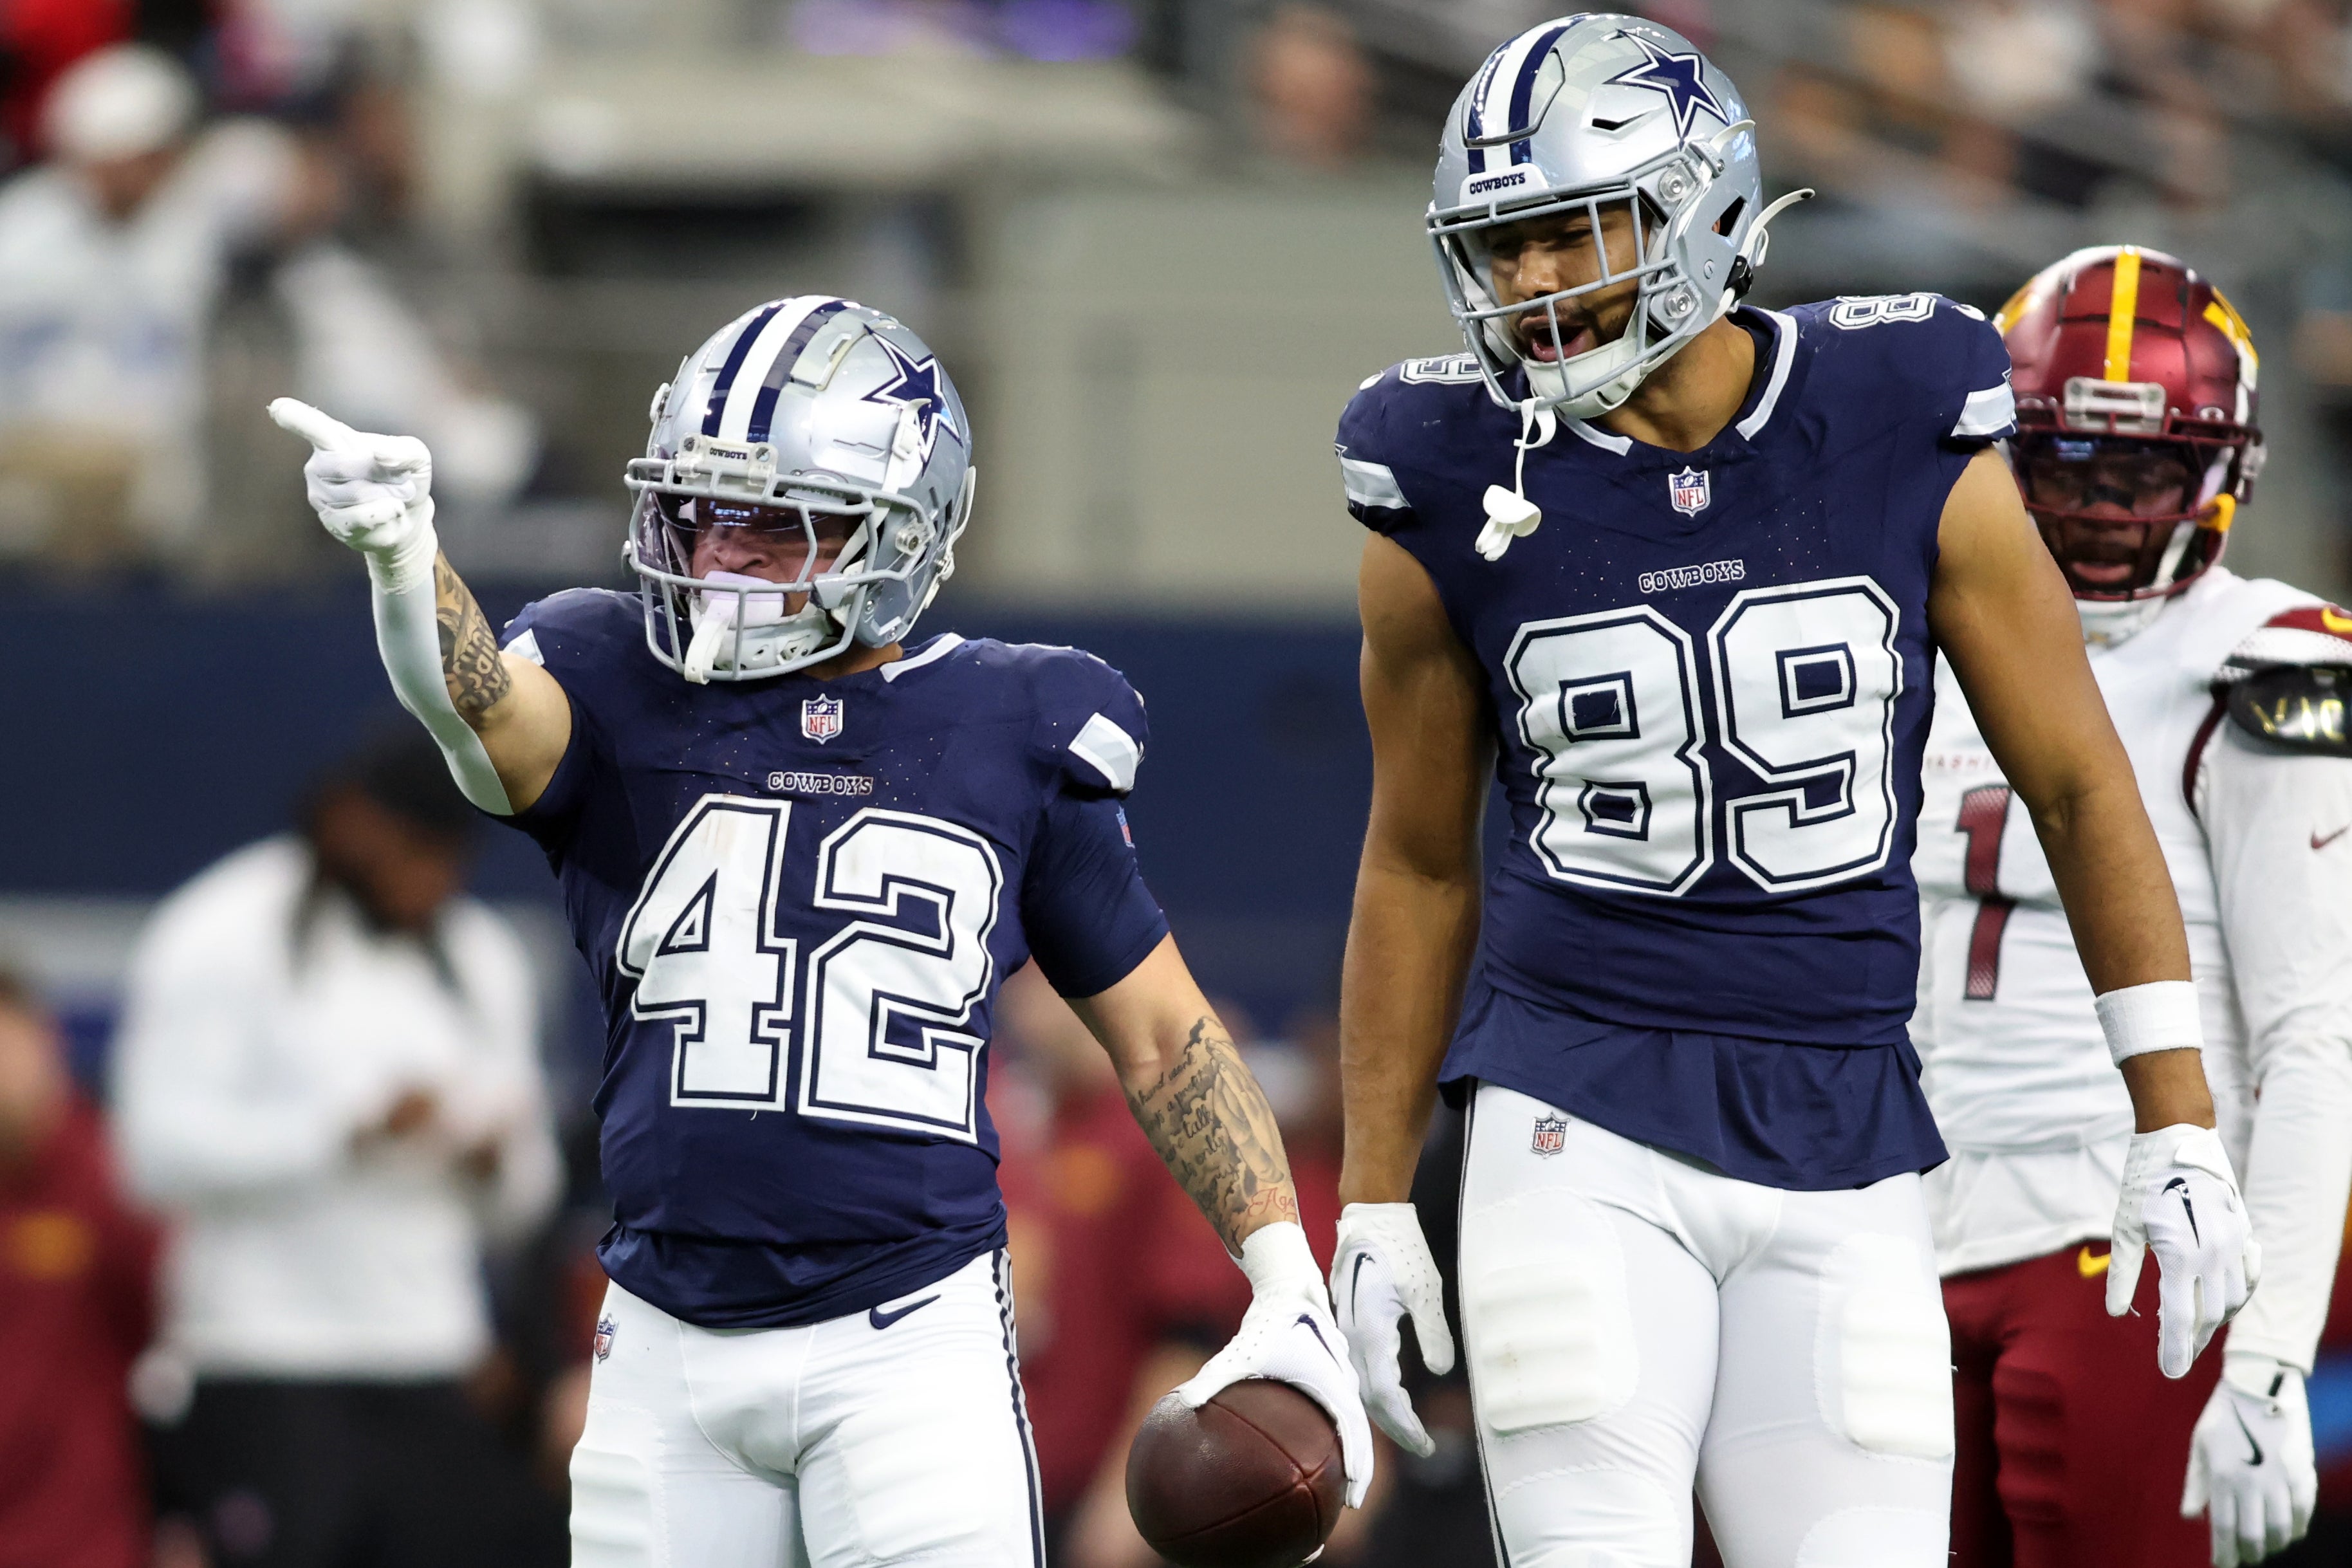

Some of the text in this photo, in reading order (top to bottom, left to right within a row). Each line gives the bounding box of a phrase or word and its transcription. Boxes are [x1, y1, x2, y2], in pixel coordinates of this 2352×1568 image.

[1469, 172, 1526, 194] COWBOYS
[1677, 488, 1704, 507] NFL
[1638, 559, 1746, 593] COWBOYS
[809, 715, 835, 734] NFL
[1503, 575, 1903, 897] 89
[768, 771, 874, 796] COWBOYS
[616, 793, 1004, 1145] 42
[1535, 1132, 1561, 1150] NFL
